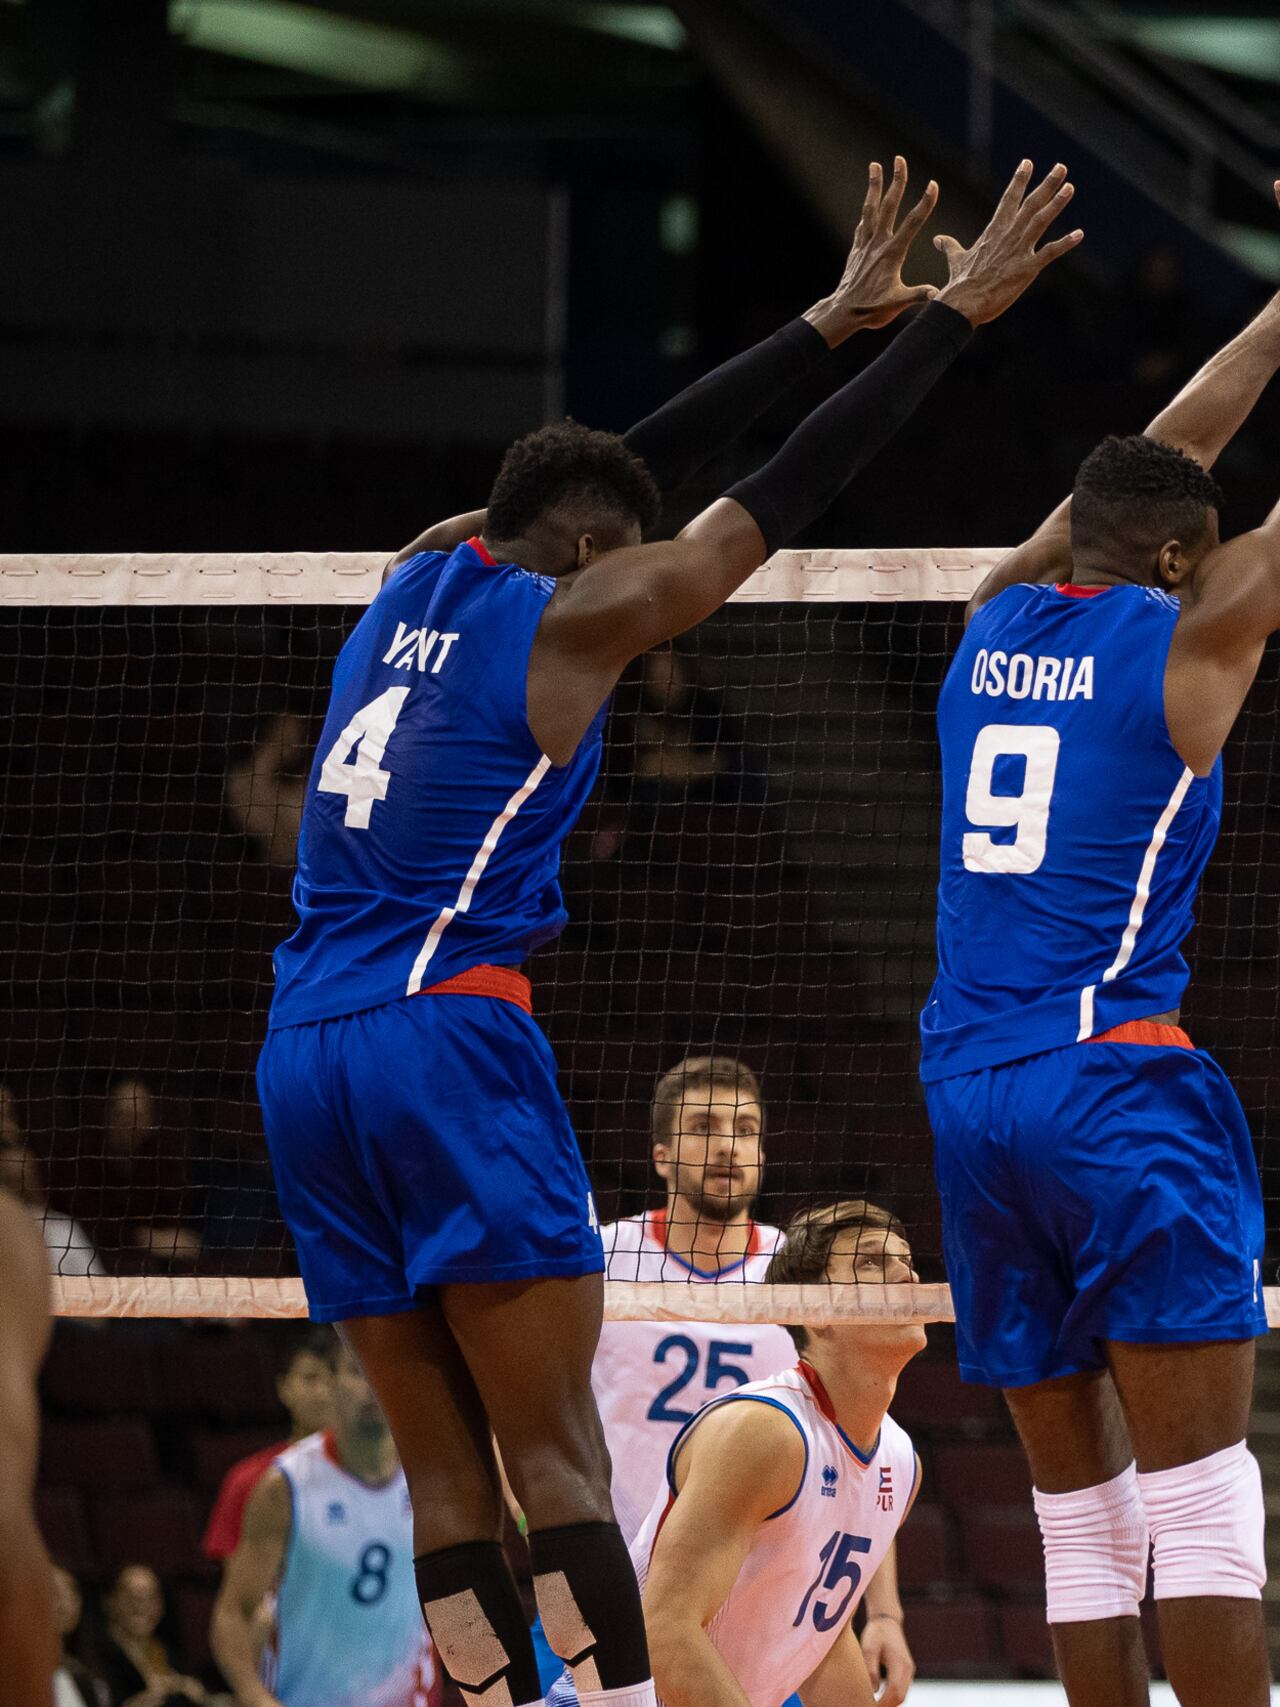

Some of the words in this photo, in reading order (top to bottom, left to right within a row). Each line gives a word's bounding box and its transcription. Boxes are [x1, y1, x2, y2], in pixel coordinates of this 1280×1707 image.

[382, 621, 460, 674] YANT
[971, 649, 1095, 701] OSORIA
[317, 686, 411, 830] 4
[962, 724, 1061, 874] 9
[647, 1334, 753, 1423] 25
[875, 1494, 895, 1512] PUR
[351, 1543, 391, 1605] 8
[792, 1531, 873, 1633] 15
